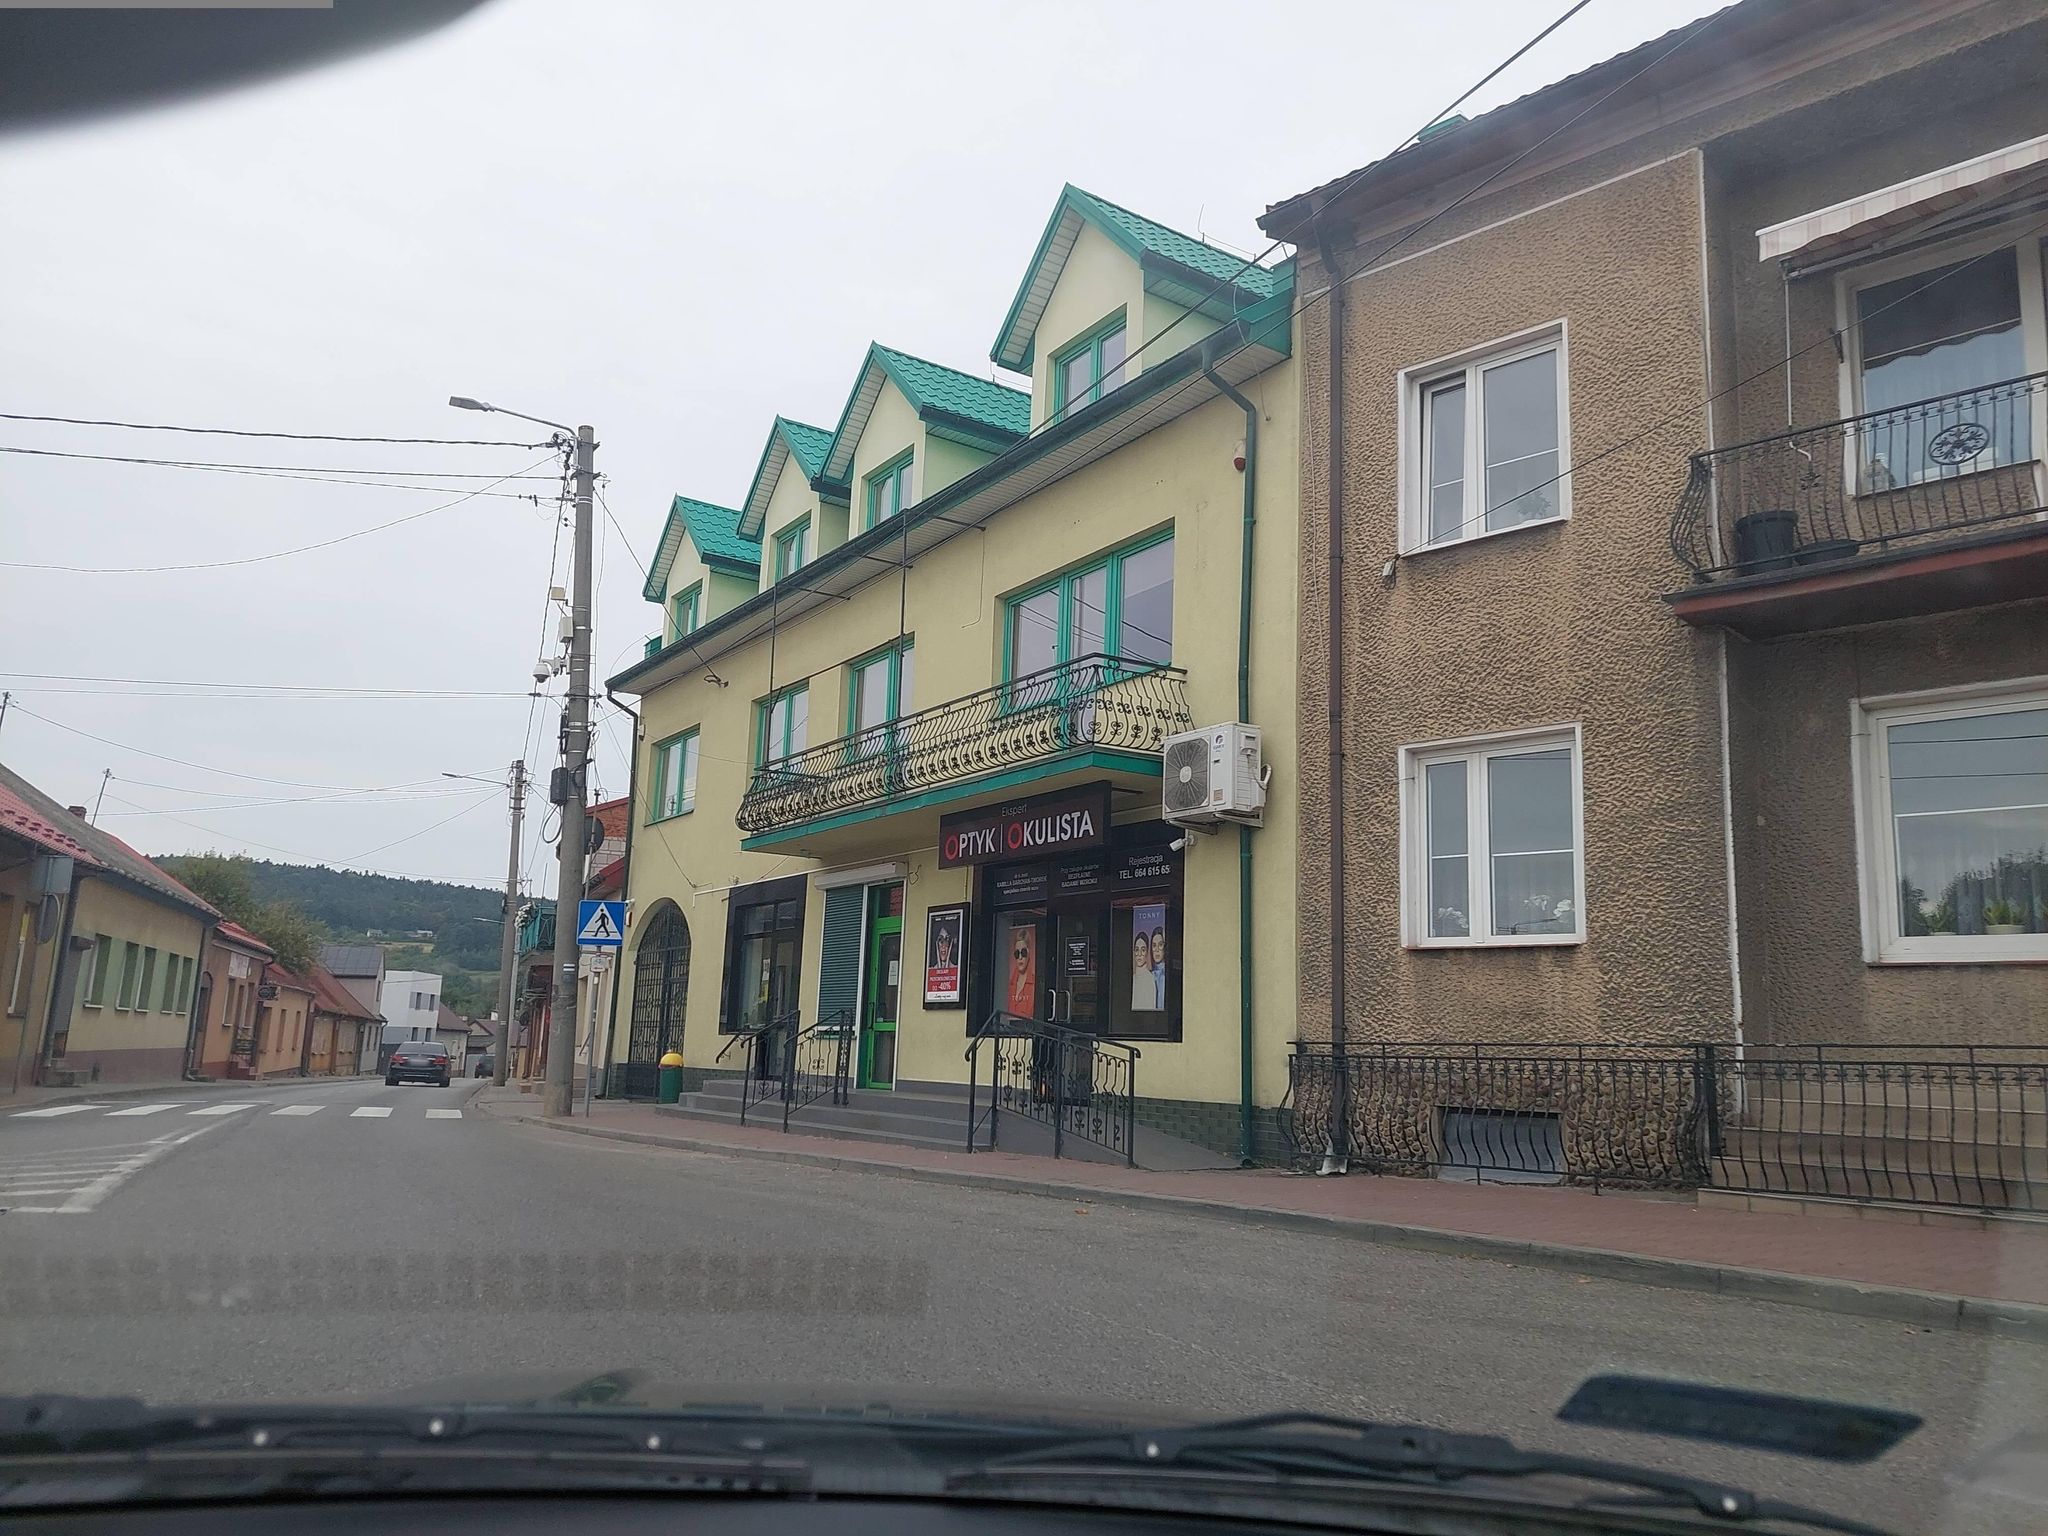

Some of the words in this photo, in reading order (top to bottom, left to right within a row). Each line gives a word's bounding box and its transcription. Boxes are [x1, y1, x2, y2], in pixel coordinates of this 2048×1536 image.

[1001, 804, 1027, 817] Ekspert
[945, 827, 996, 860] OPTYK
[1007, 810, 1095, 849] OKULISTA
[1129, 853, 1164, 867] Rejestracja
[1134, 868, 1147, 878] 664
[1147, 866, 1160, 876] 615
